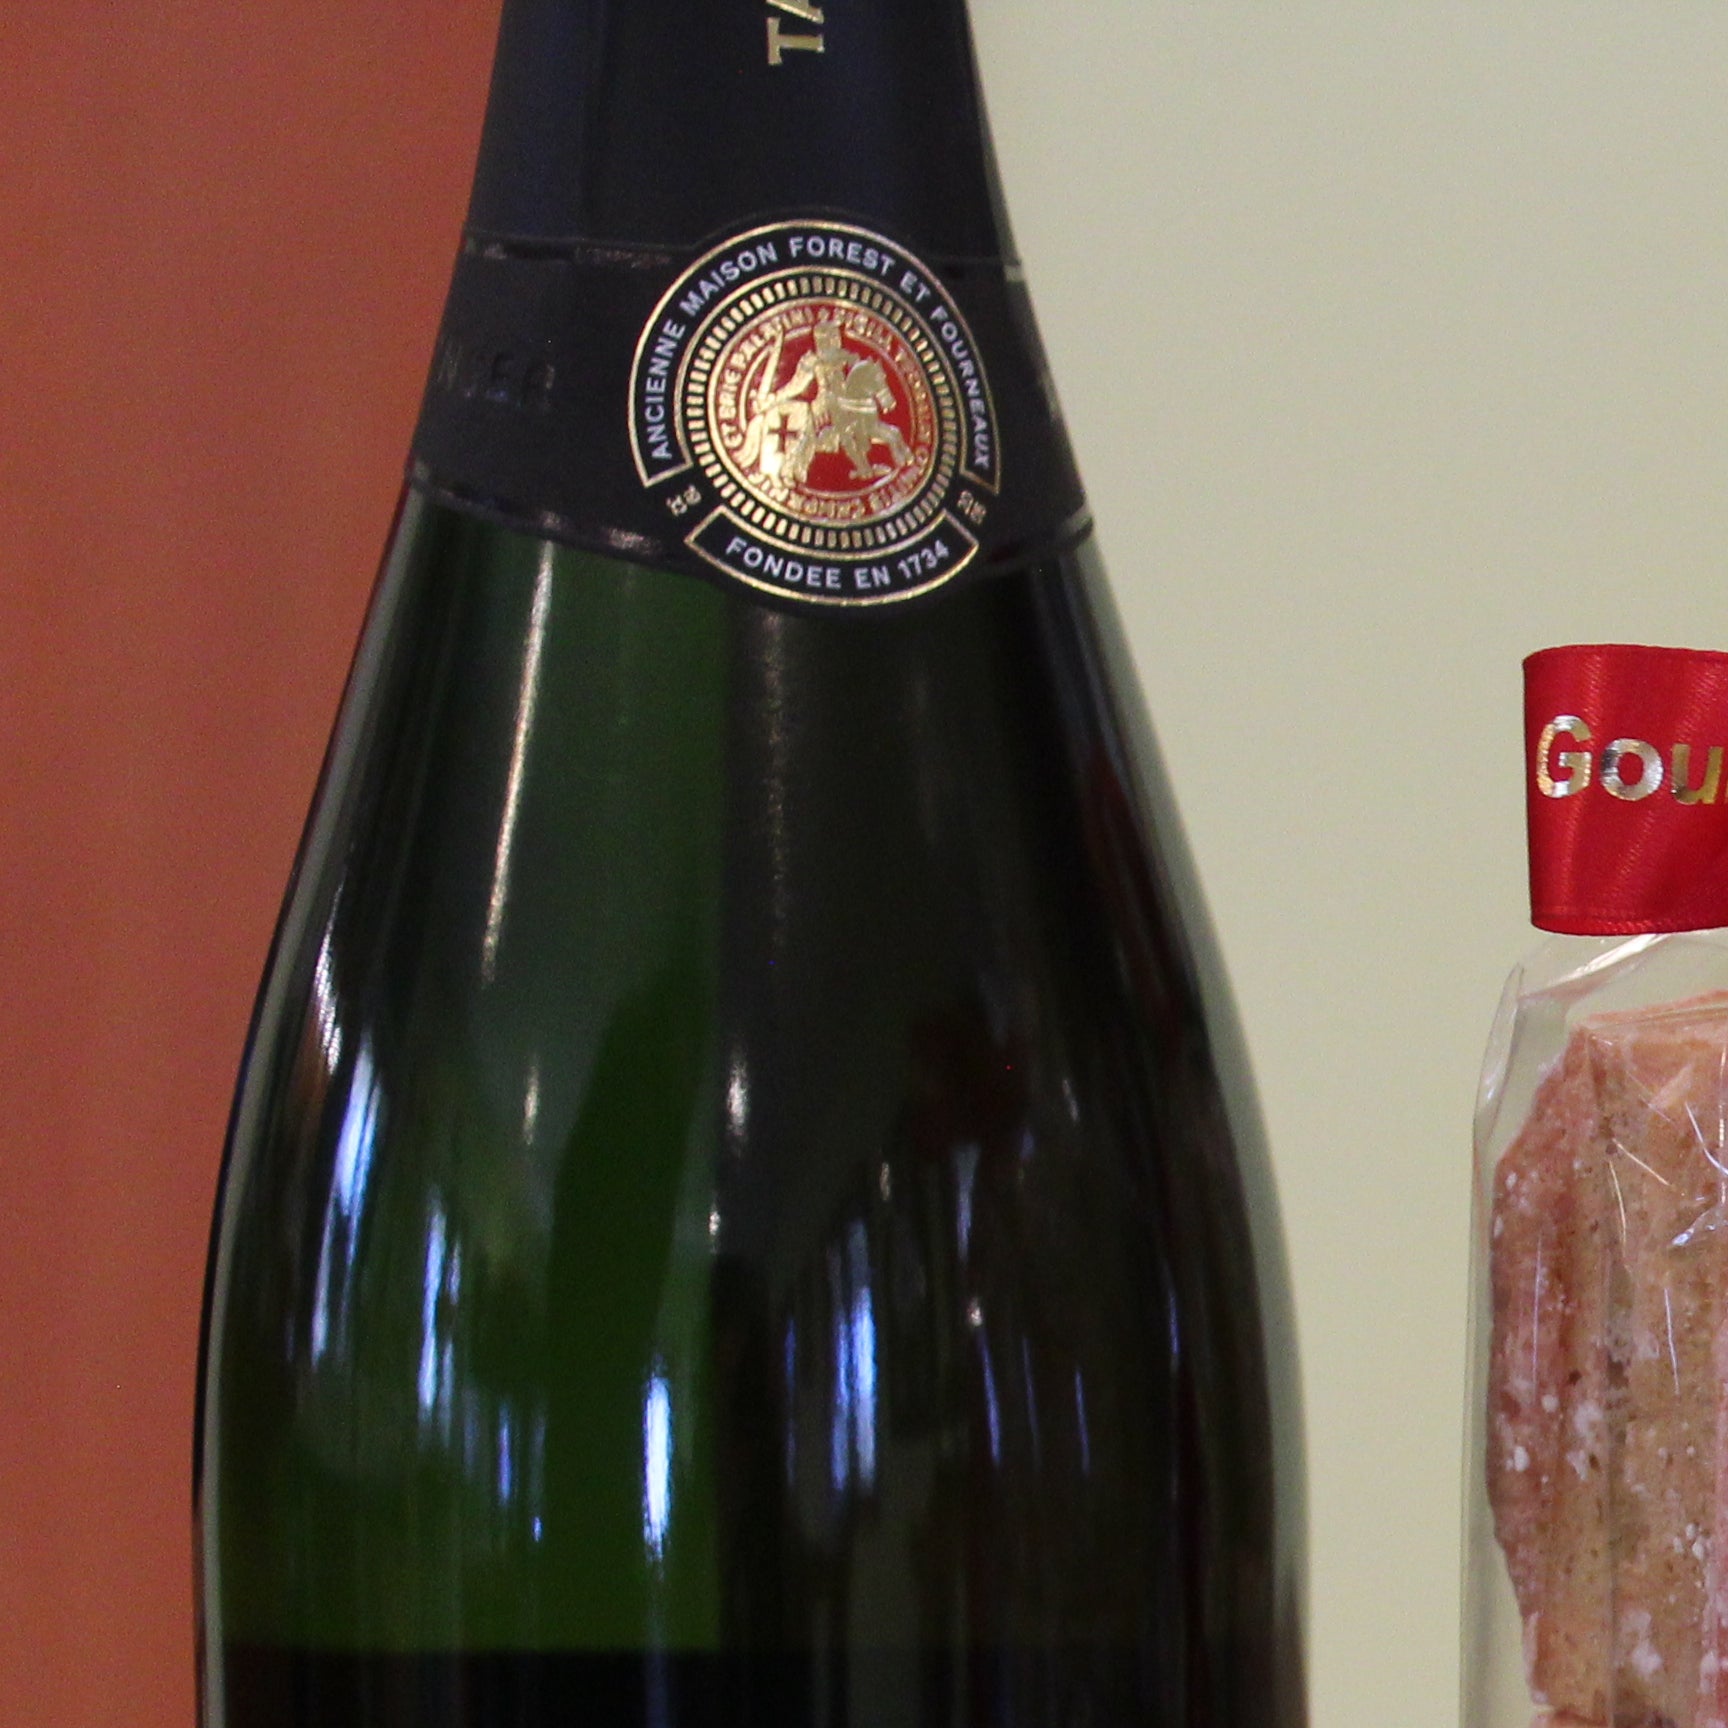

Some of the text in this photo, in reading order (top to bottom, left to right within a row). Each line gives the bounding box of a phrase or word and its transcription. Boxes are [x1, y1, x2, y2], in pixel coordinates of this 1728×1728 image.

[645, 237, 990, 469] ANCIENNE MAISON FOREST ET FOURNEAUX
[854, 564, 891, 590] EN
[898, 539, 949, 580] 1734
